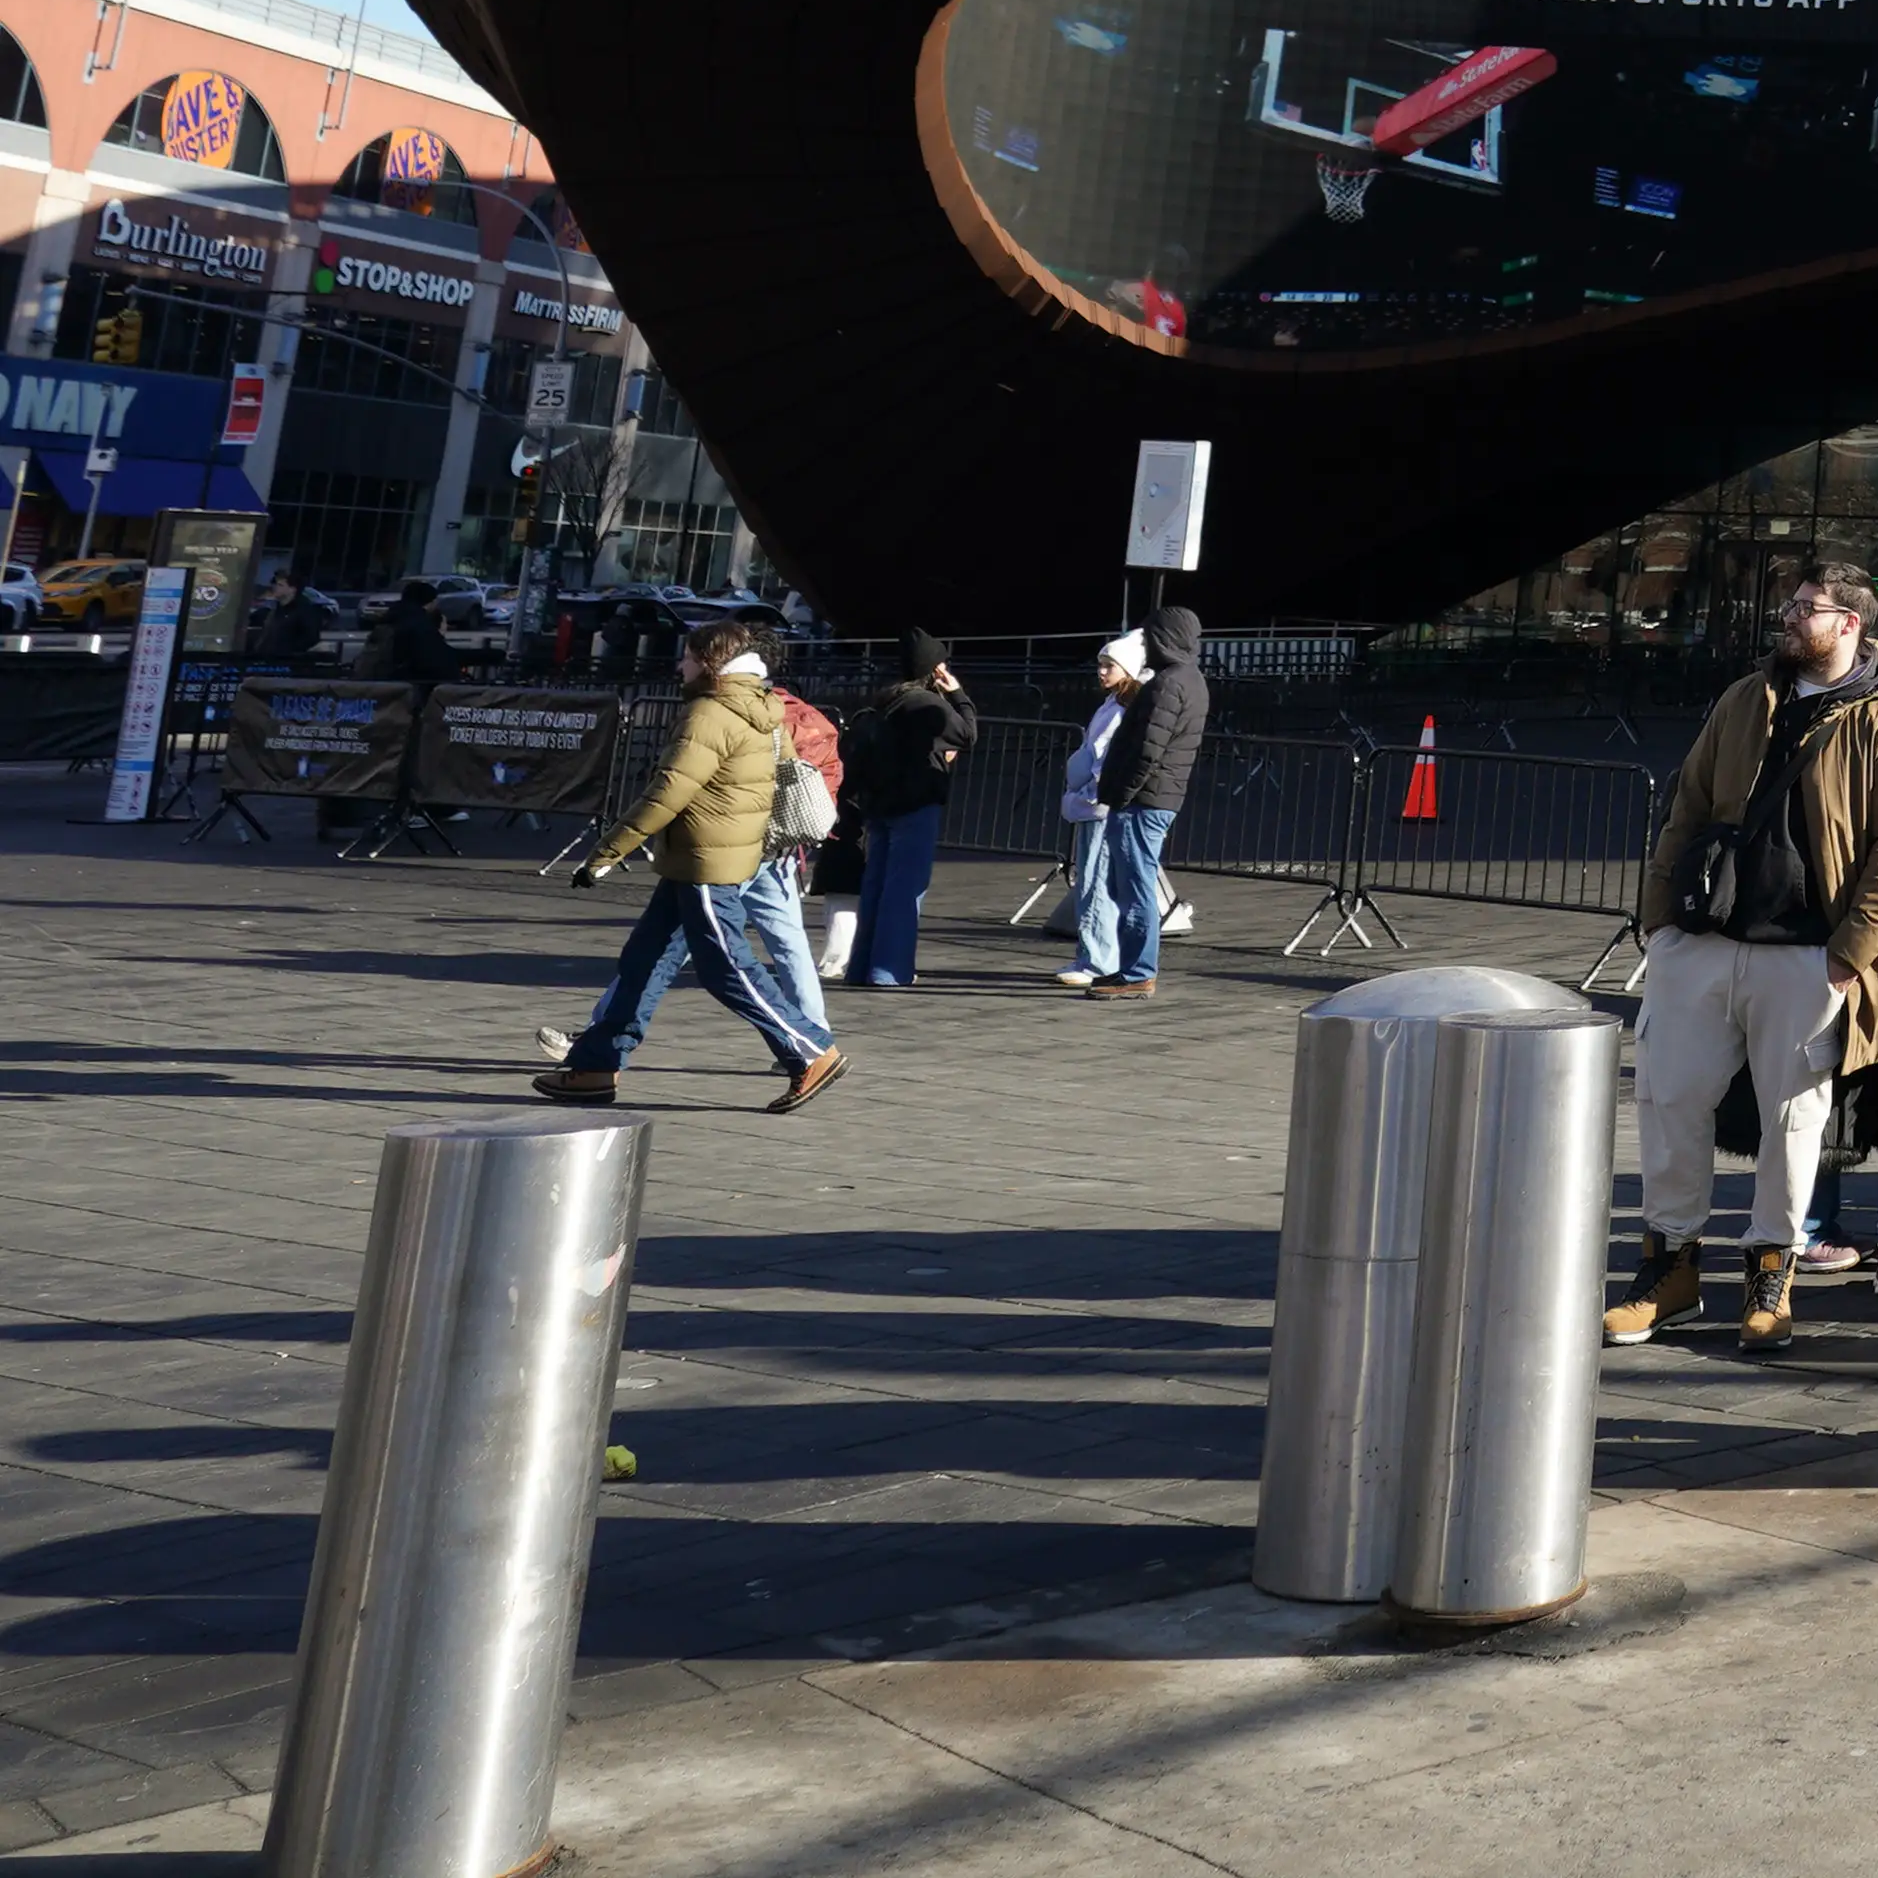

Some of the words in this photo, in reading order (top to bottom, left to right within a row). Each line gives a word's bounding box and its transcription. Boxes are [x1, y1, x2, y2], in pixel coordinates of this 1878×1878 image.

[99, 198, 268, 277] Burlington
[12, 375, 137, 438] NAVY
[535, 389, 565, 407] 25
[502, 709, 520, 726] THIS
[521, 710, 545, 727] POINT
[553, 712, 586, 730] LIMITED
[586, 714, 597, 730] TO
[450, 726, 474, 743] TICKET
[475, 728, 508, 745] HOLDERS
[509, 730, 524, 745] FOR
[557, 733, 583, 750] EVENT
